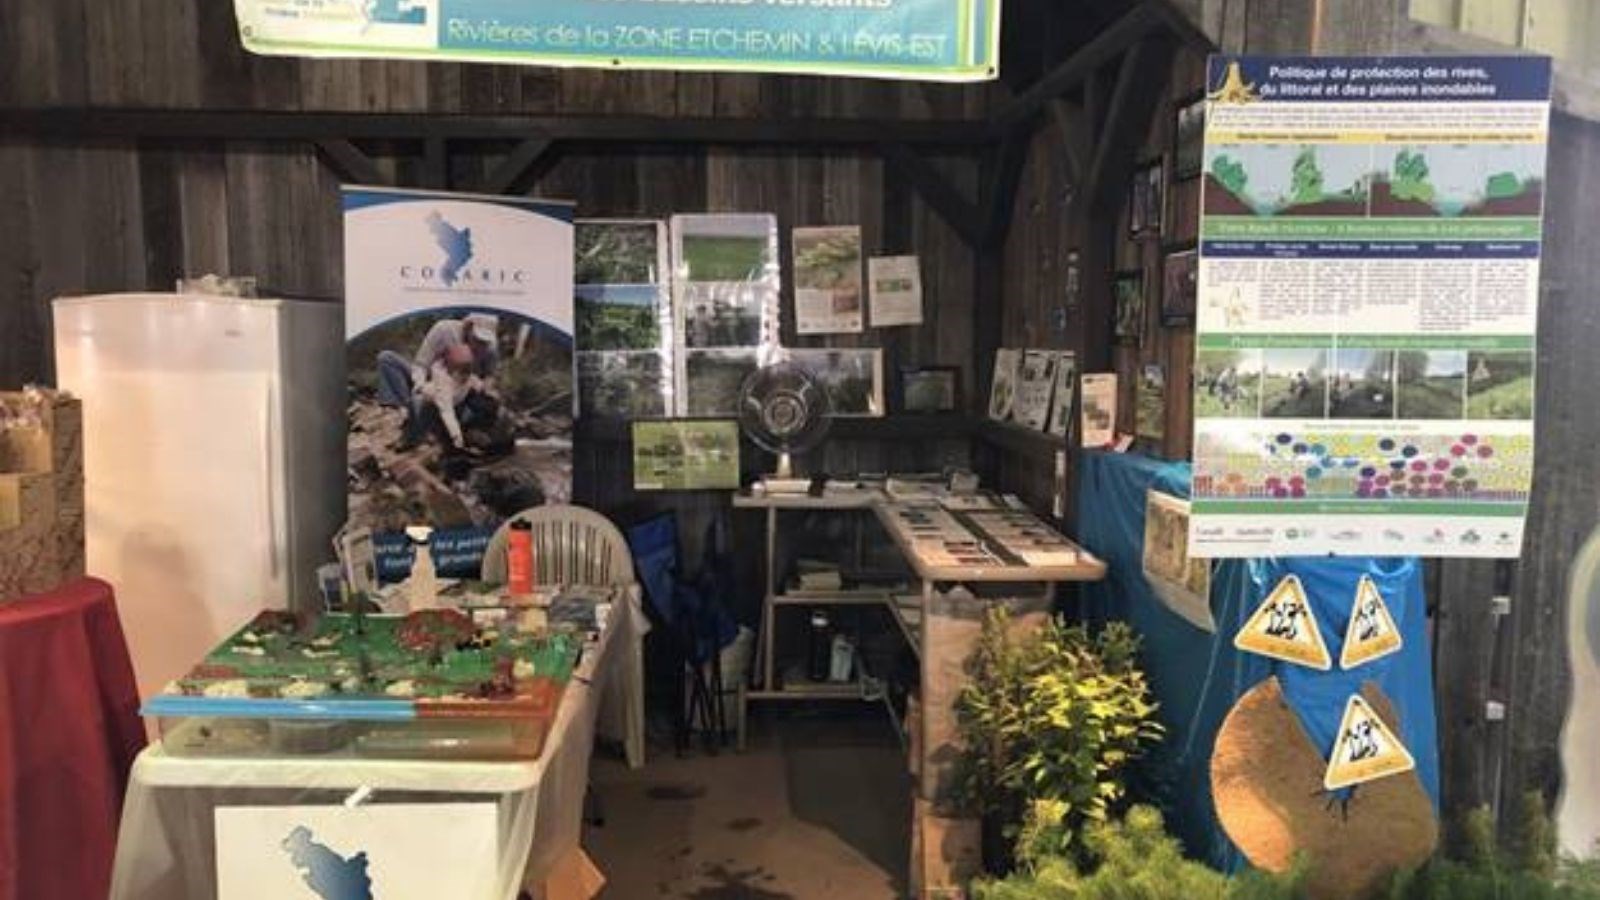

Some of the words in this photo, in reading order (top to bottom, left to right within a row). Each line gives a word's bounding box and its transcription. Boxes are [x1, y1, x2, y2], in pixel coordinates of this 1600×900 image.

[448, 18, 538, 43] Rivières
[545, 24, 579, 44] de
[584, 25, 610, 48] la
[614, 26, 681, 49] ZONE
[689, 28, 811, 54] ETCHEMIN
[818, 33, 836, 54] &
[1269, 66, 1327, 80] Politique
[1330, 66, 1347, 78] de
[1350, 66, 1420, 80] protection
[1423, 67, 1448, 78] des
[1260, 83, 1277, 95] du
[1280, 83, 1322, 95] littoral
[1325, 84, 1339, 96] et
[1342, 83, 1366, 96] des
[1369, 83, 1418, 98] plaines
[1421, 83, 1497, 96] inondables
